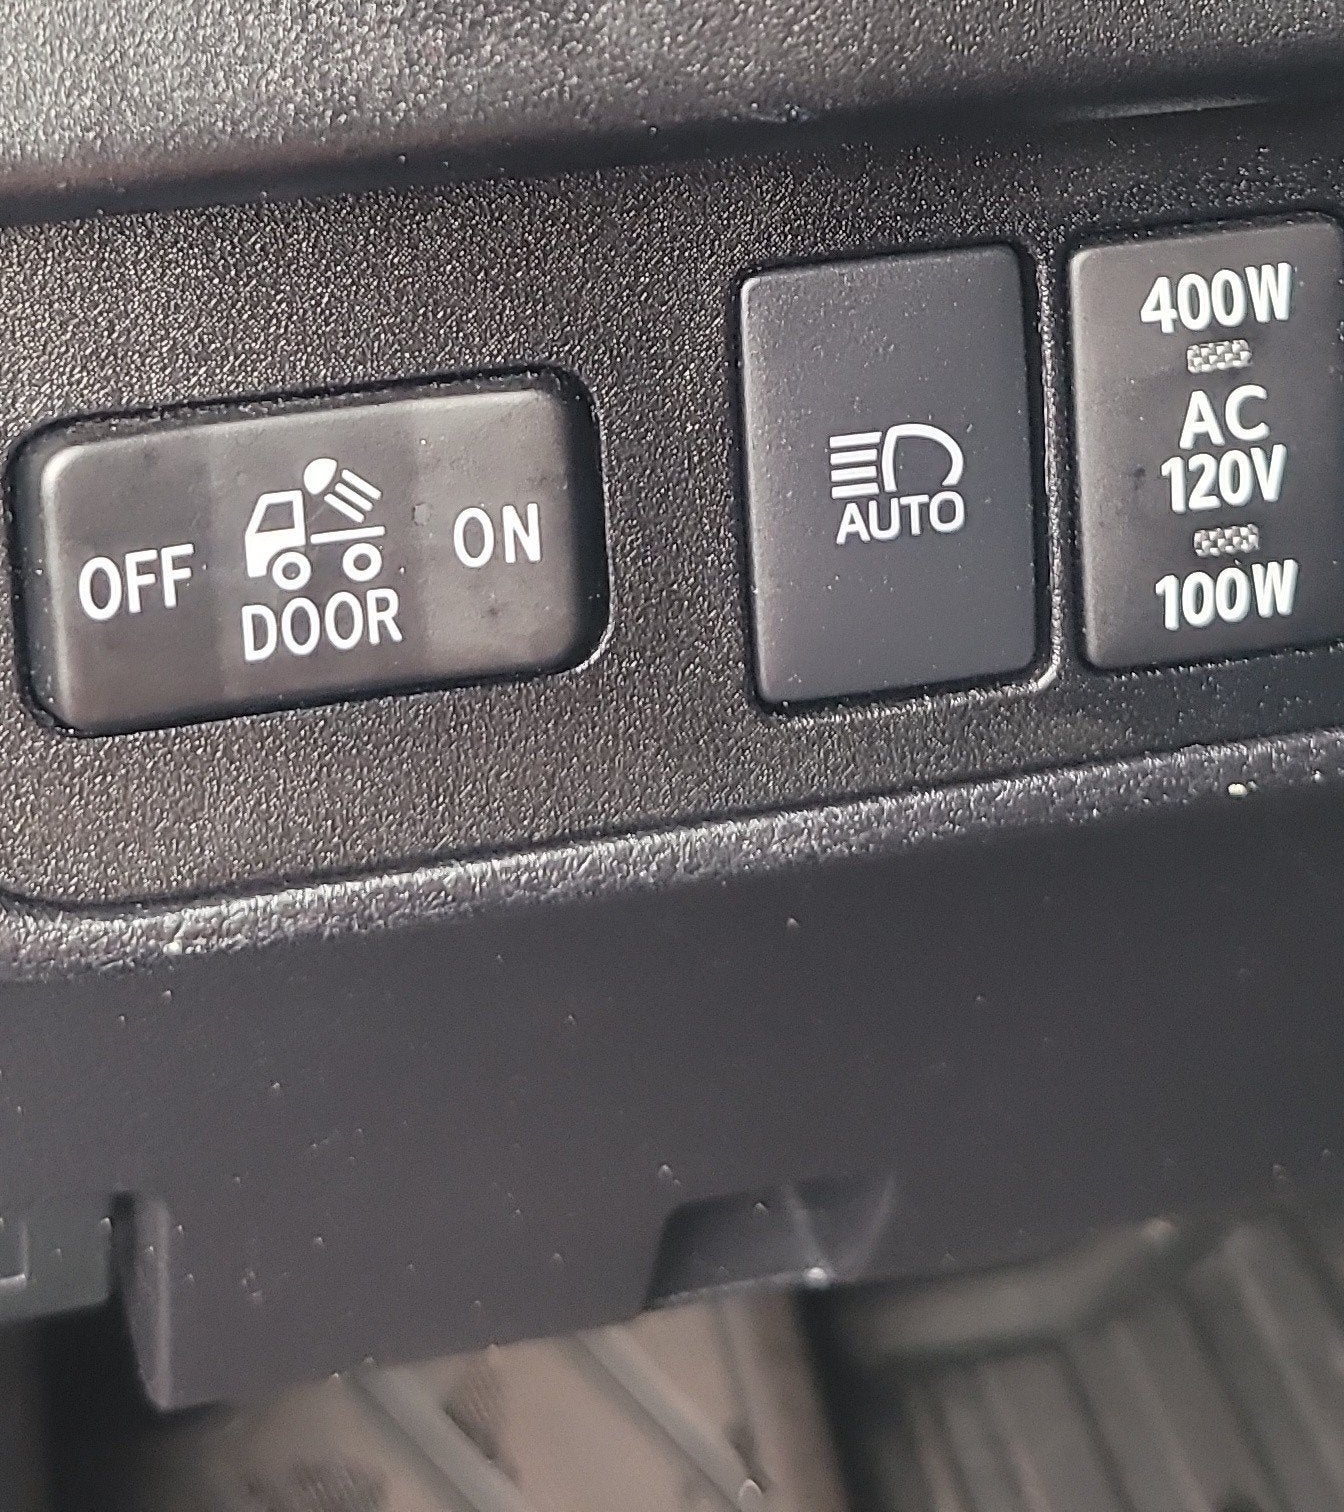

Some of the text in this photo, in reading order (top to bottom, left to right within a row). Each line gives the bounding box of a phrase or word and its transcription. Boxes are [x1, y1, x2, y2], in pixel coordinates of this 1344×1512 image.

[1139, 261, 1293, 334] 400W
[1178, 384, 1271, 450] AC
[1160, 444, 1287, 514] 120V
[453, 502, 542, 568] ON
[835, 490, 965, 545] AUTO
[78, 543, 195, 621] OFF
[1154, 559, 1299, 631] 100W
[241, 588, 404, 662] DOOR
